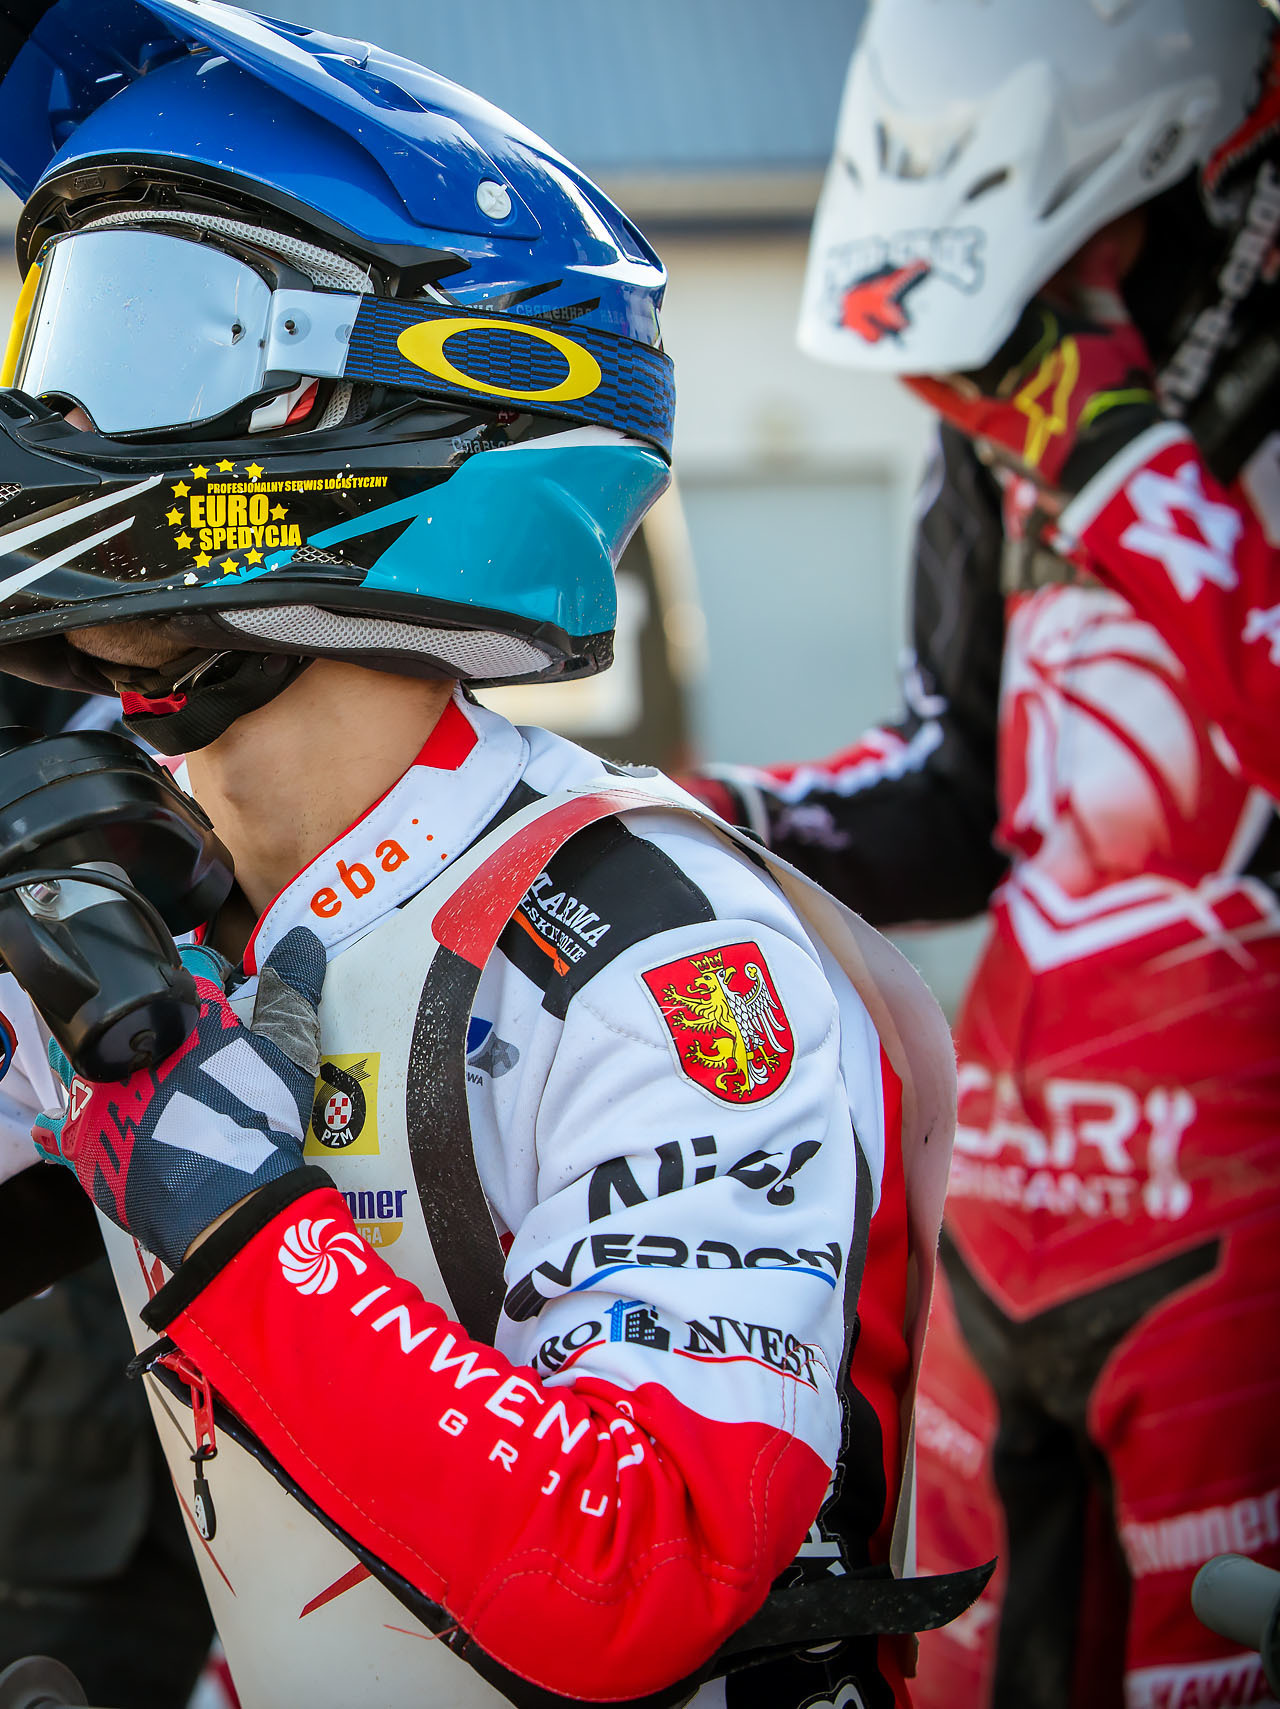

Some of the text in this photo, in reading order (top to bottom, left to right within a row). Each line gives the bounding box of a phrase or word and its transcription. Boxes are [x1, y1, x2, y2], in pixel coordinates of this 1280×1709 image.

[207, 476, 389, 495] PROFESJONALNY SERWIS LOGISTYCZNY
[189, 493, 270, 529] EURO
[199, 523, 302, 552] SPEDYCJA
[320, 1127, 355, 1147] PZM
[342, 1189, 408, 1220] nner
[531, 1320, 602, 1380] RO
[349, 1285, 645, 1482] INWEN
